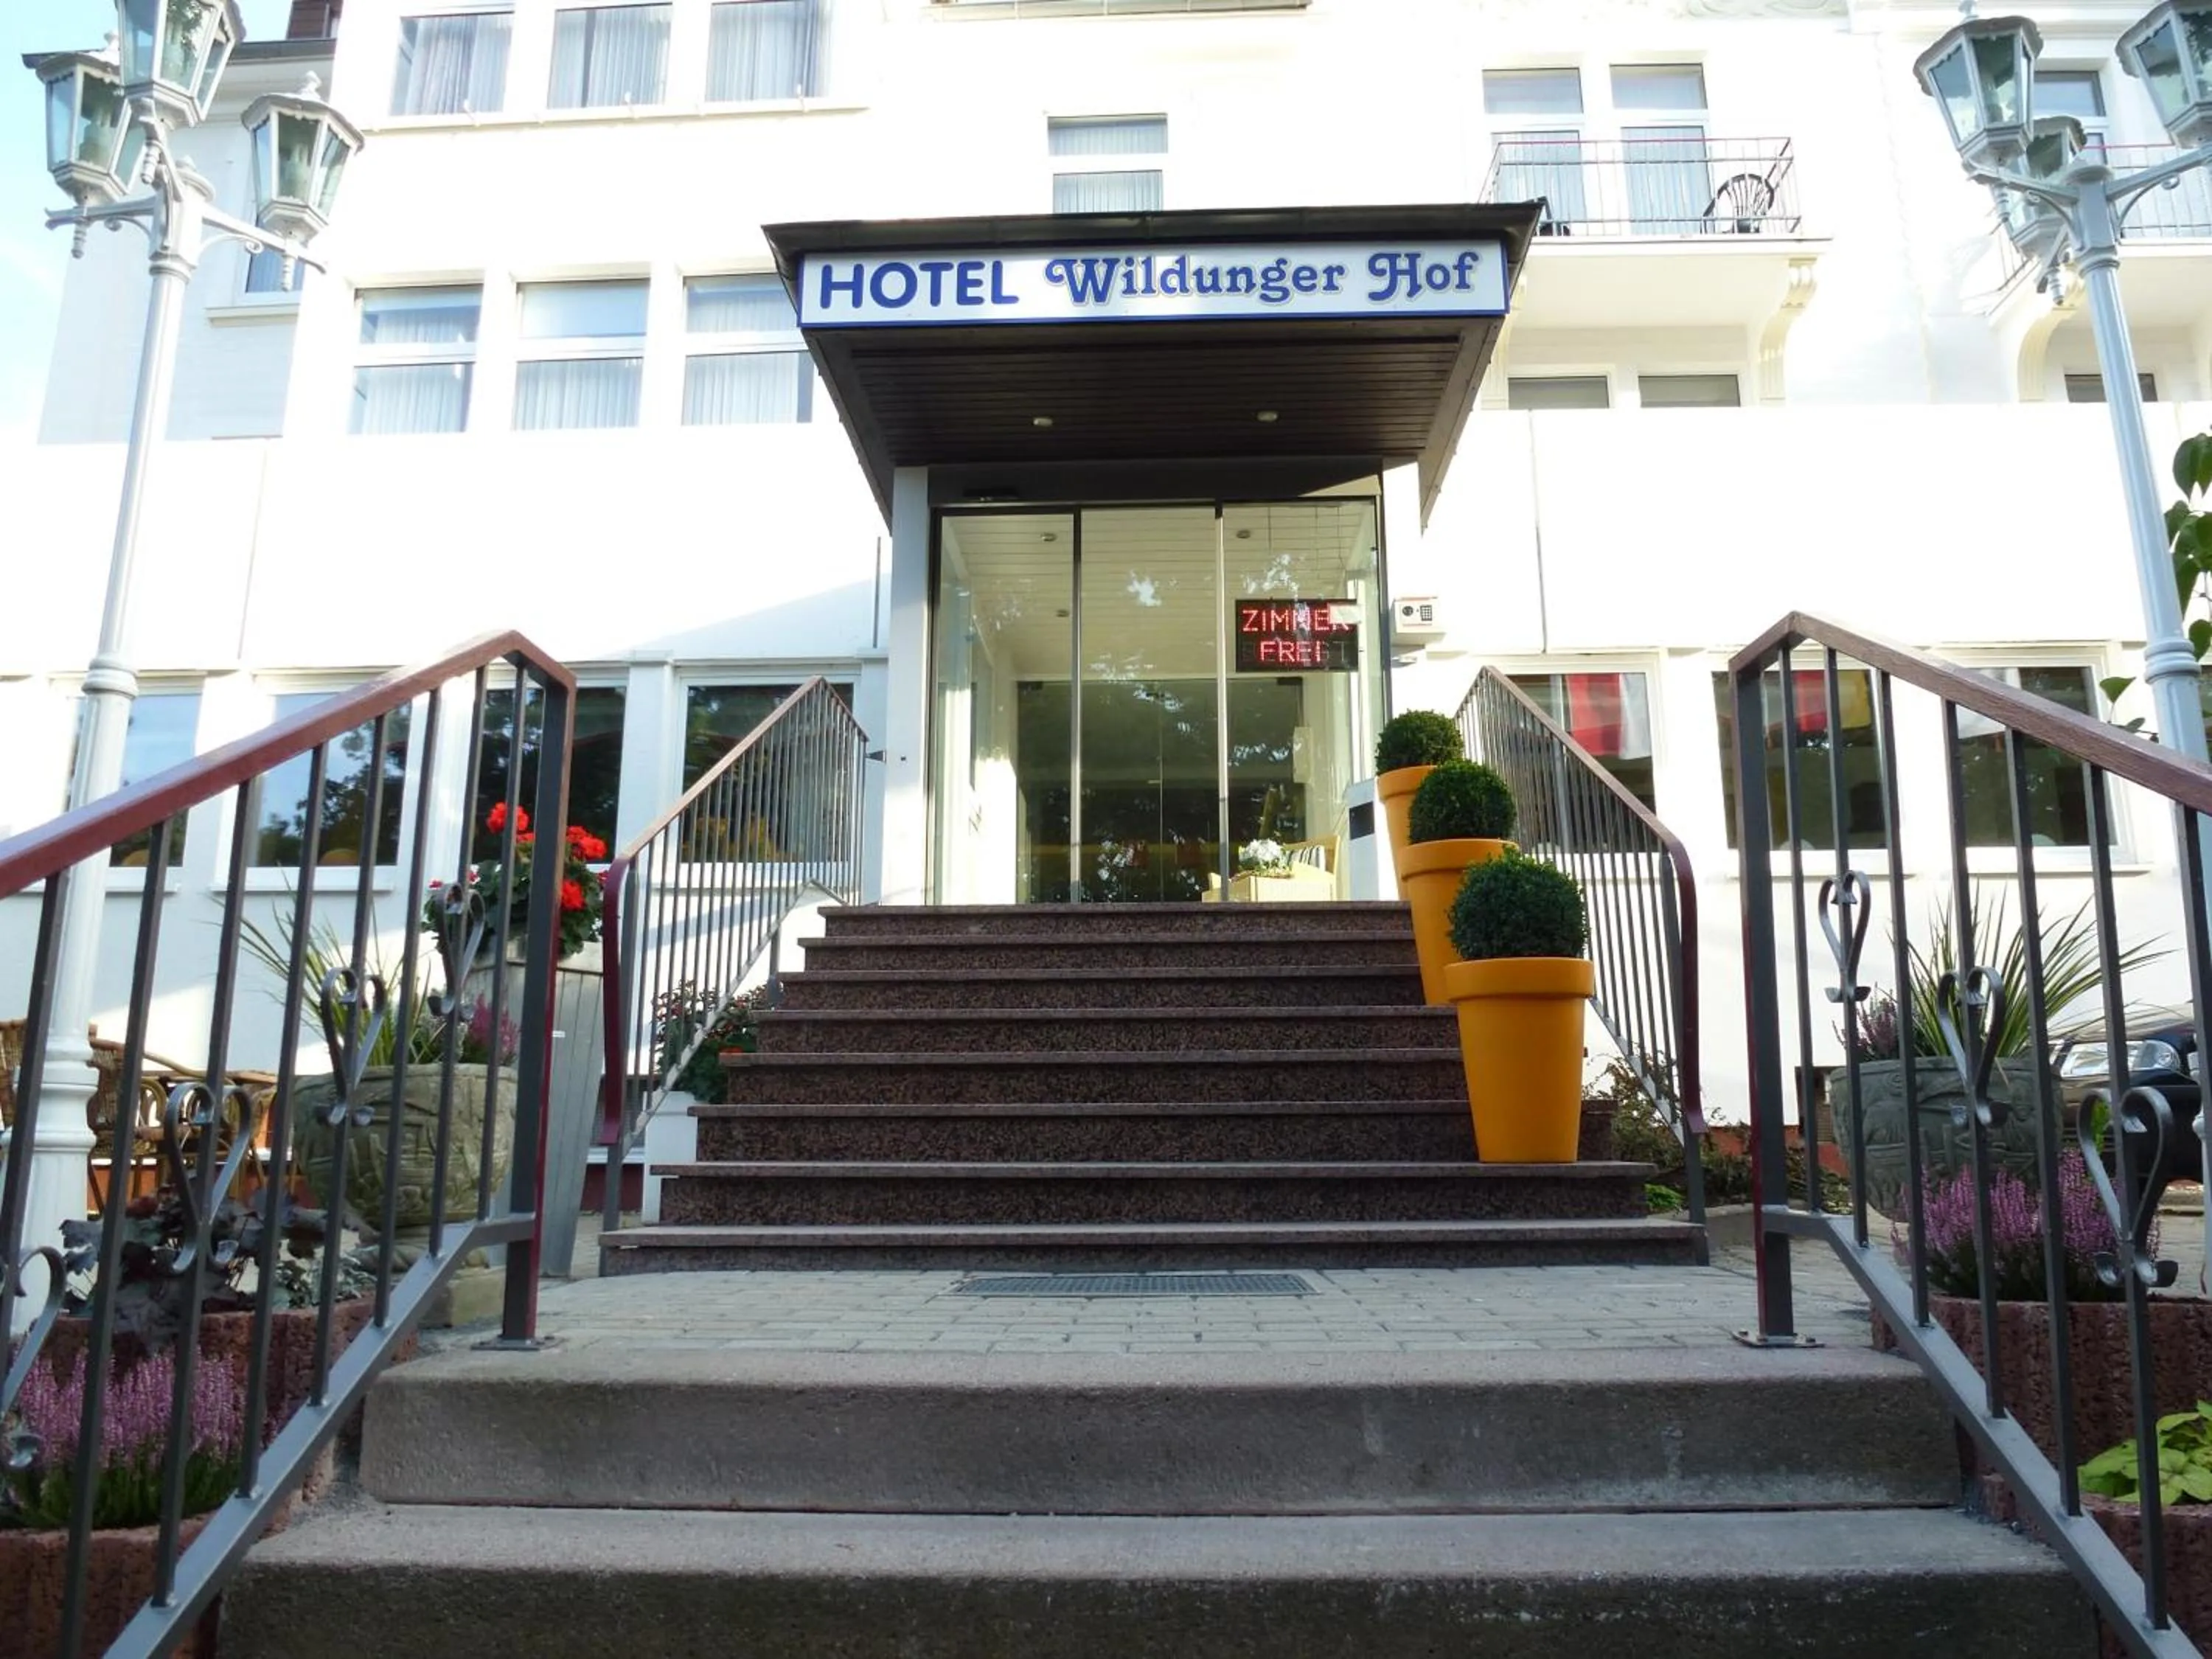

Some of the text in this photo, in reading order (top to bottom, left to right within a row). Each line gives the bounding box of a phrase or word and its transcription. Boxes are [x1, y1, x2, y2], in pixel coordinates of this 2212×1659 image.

[820, 251, 1479, 309] HOTEL Wildunger Hof
[1259, 640, 1321, 662] FREI
